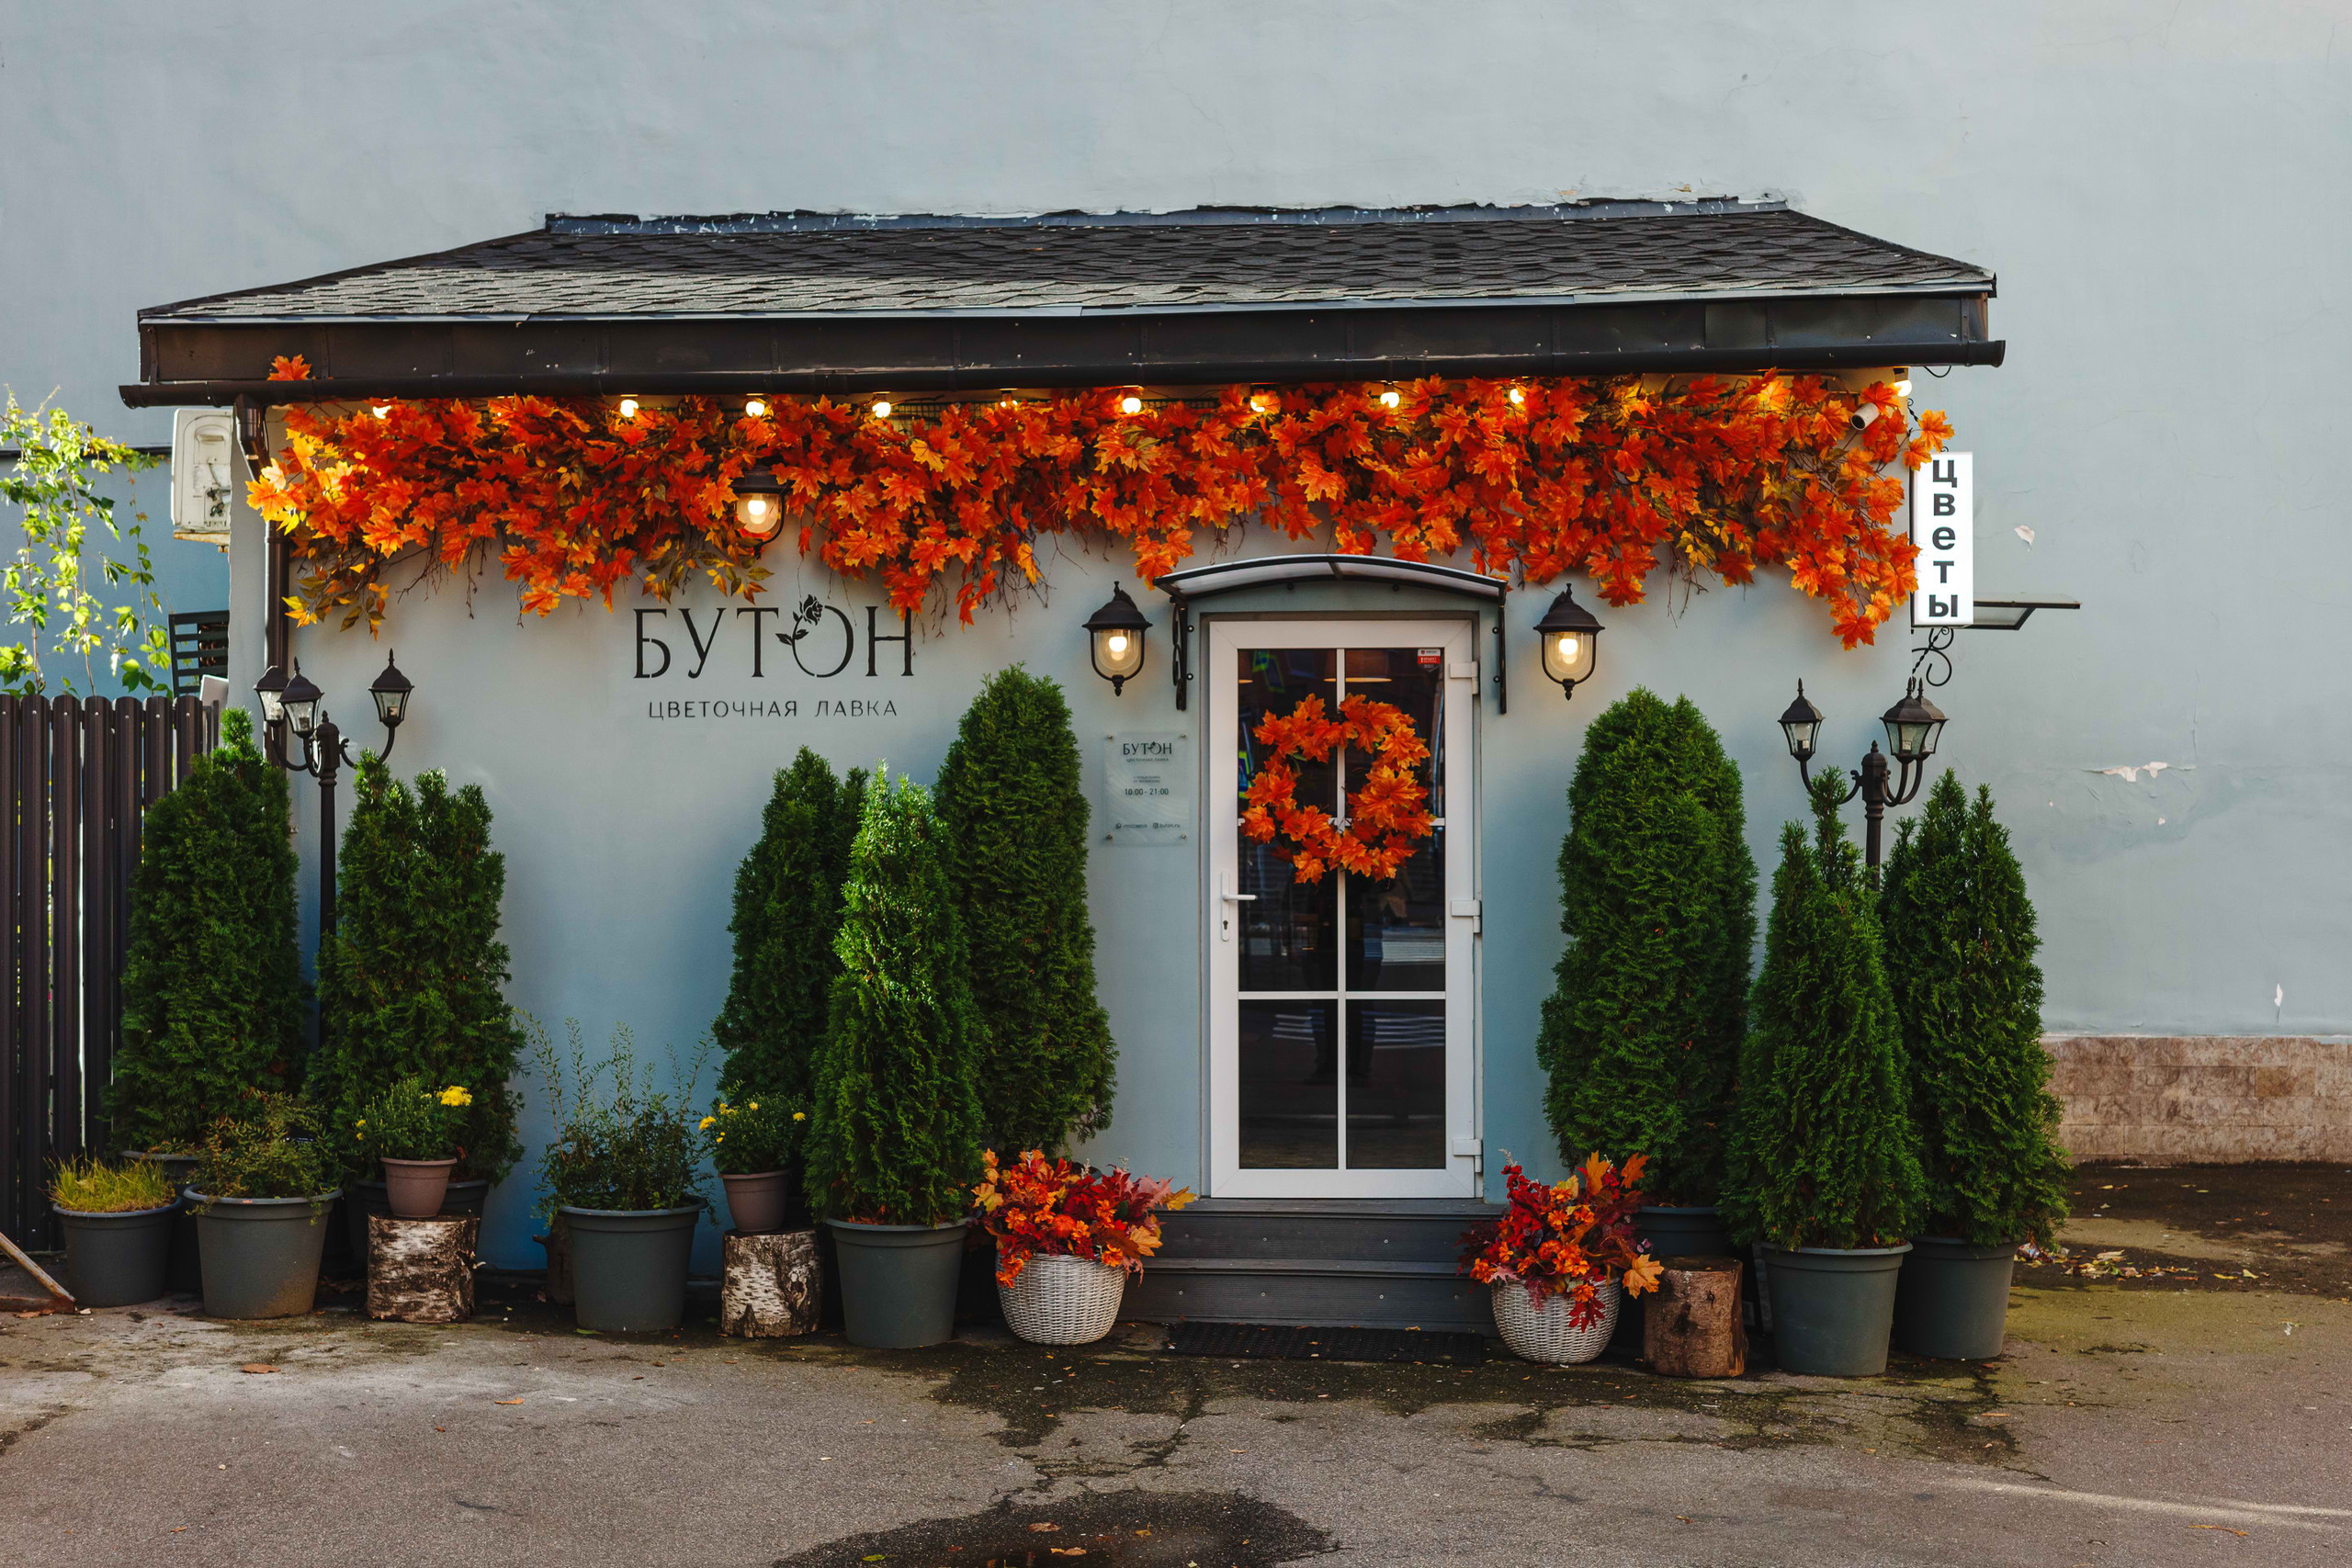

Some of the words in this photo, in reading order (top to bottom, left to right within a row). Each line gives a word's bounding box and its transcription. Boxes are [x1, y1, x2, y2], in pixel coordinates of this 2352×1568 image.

[632, 597, 915, 680] БУТОН
[648, 700, 798, 721] ЦВЕТОЧНАЯ
[813, 699, 899, 717] ЛАВКА
[1123, 741, 1172, 755] БУТОН
[1149, 787, 1170, 795] 21:00
